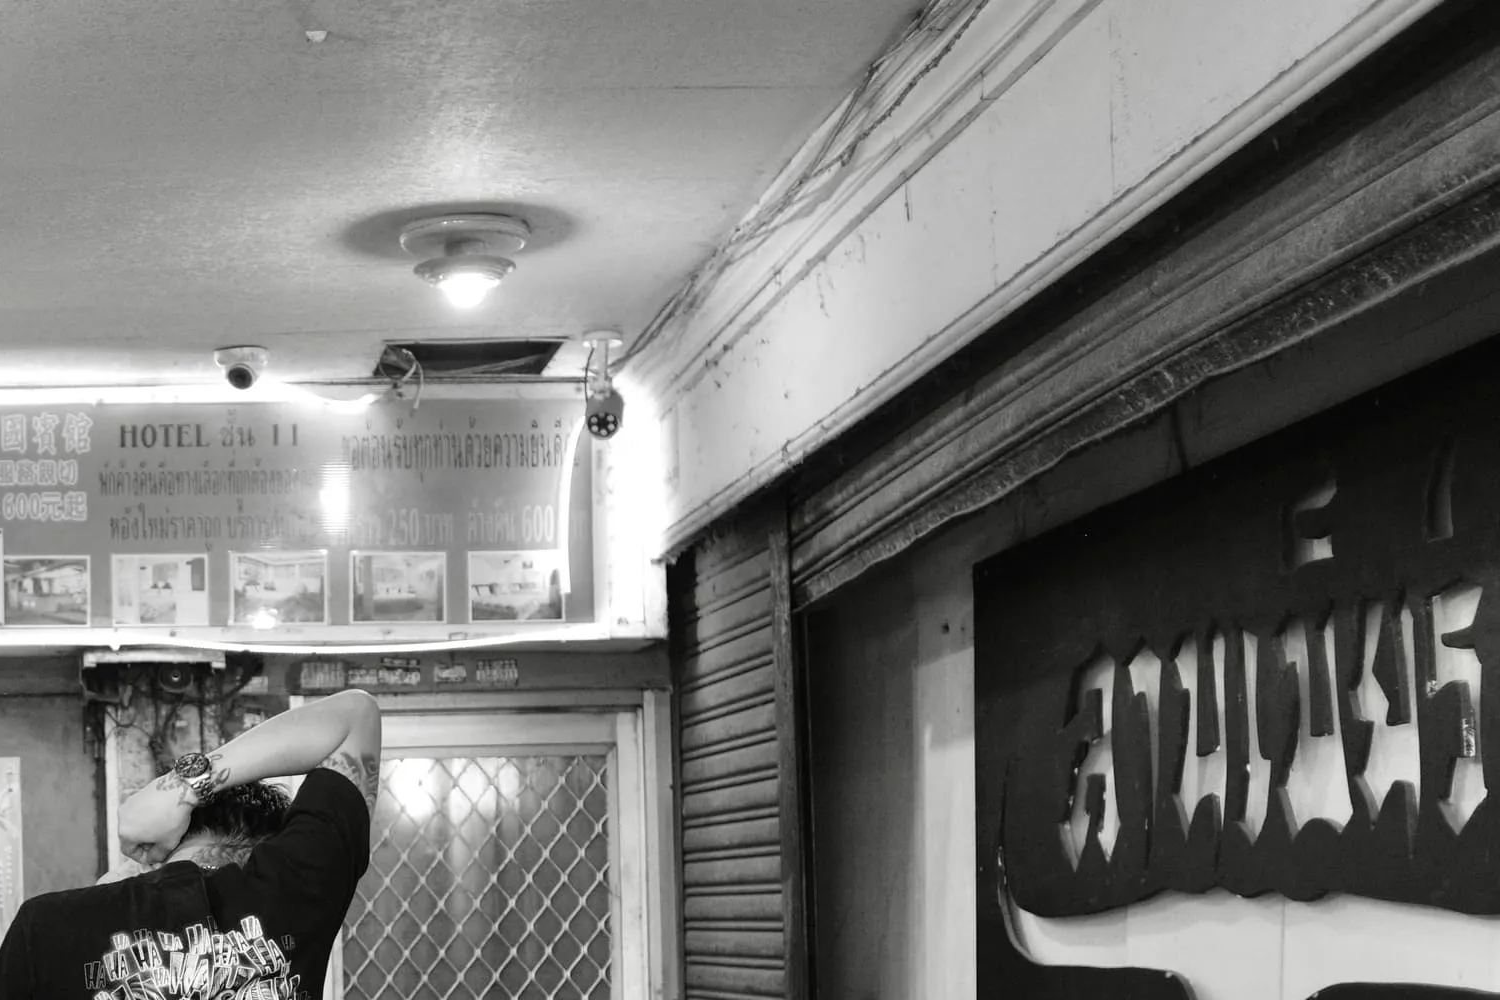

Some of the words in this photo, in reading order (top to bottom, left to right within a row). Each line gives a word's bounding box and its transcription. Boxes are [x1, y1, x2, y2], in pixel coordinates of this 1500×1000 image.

[119, 423, 211, 448] HOTEL
[521, 503, 555, 543] 600
[103, 950, 130, 982] HA
[130, 938, 163, 973] HA
[244, 936, 286, 977] HA
